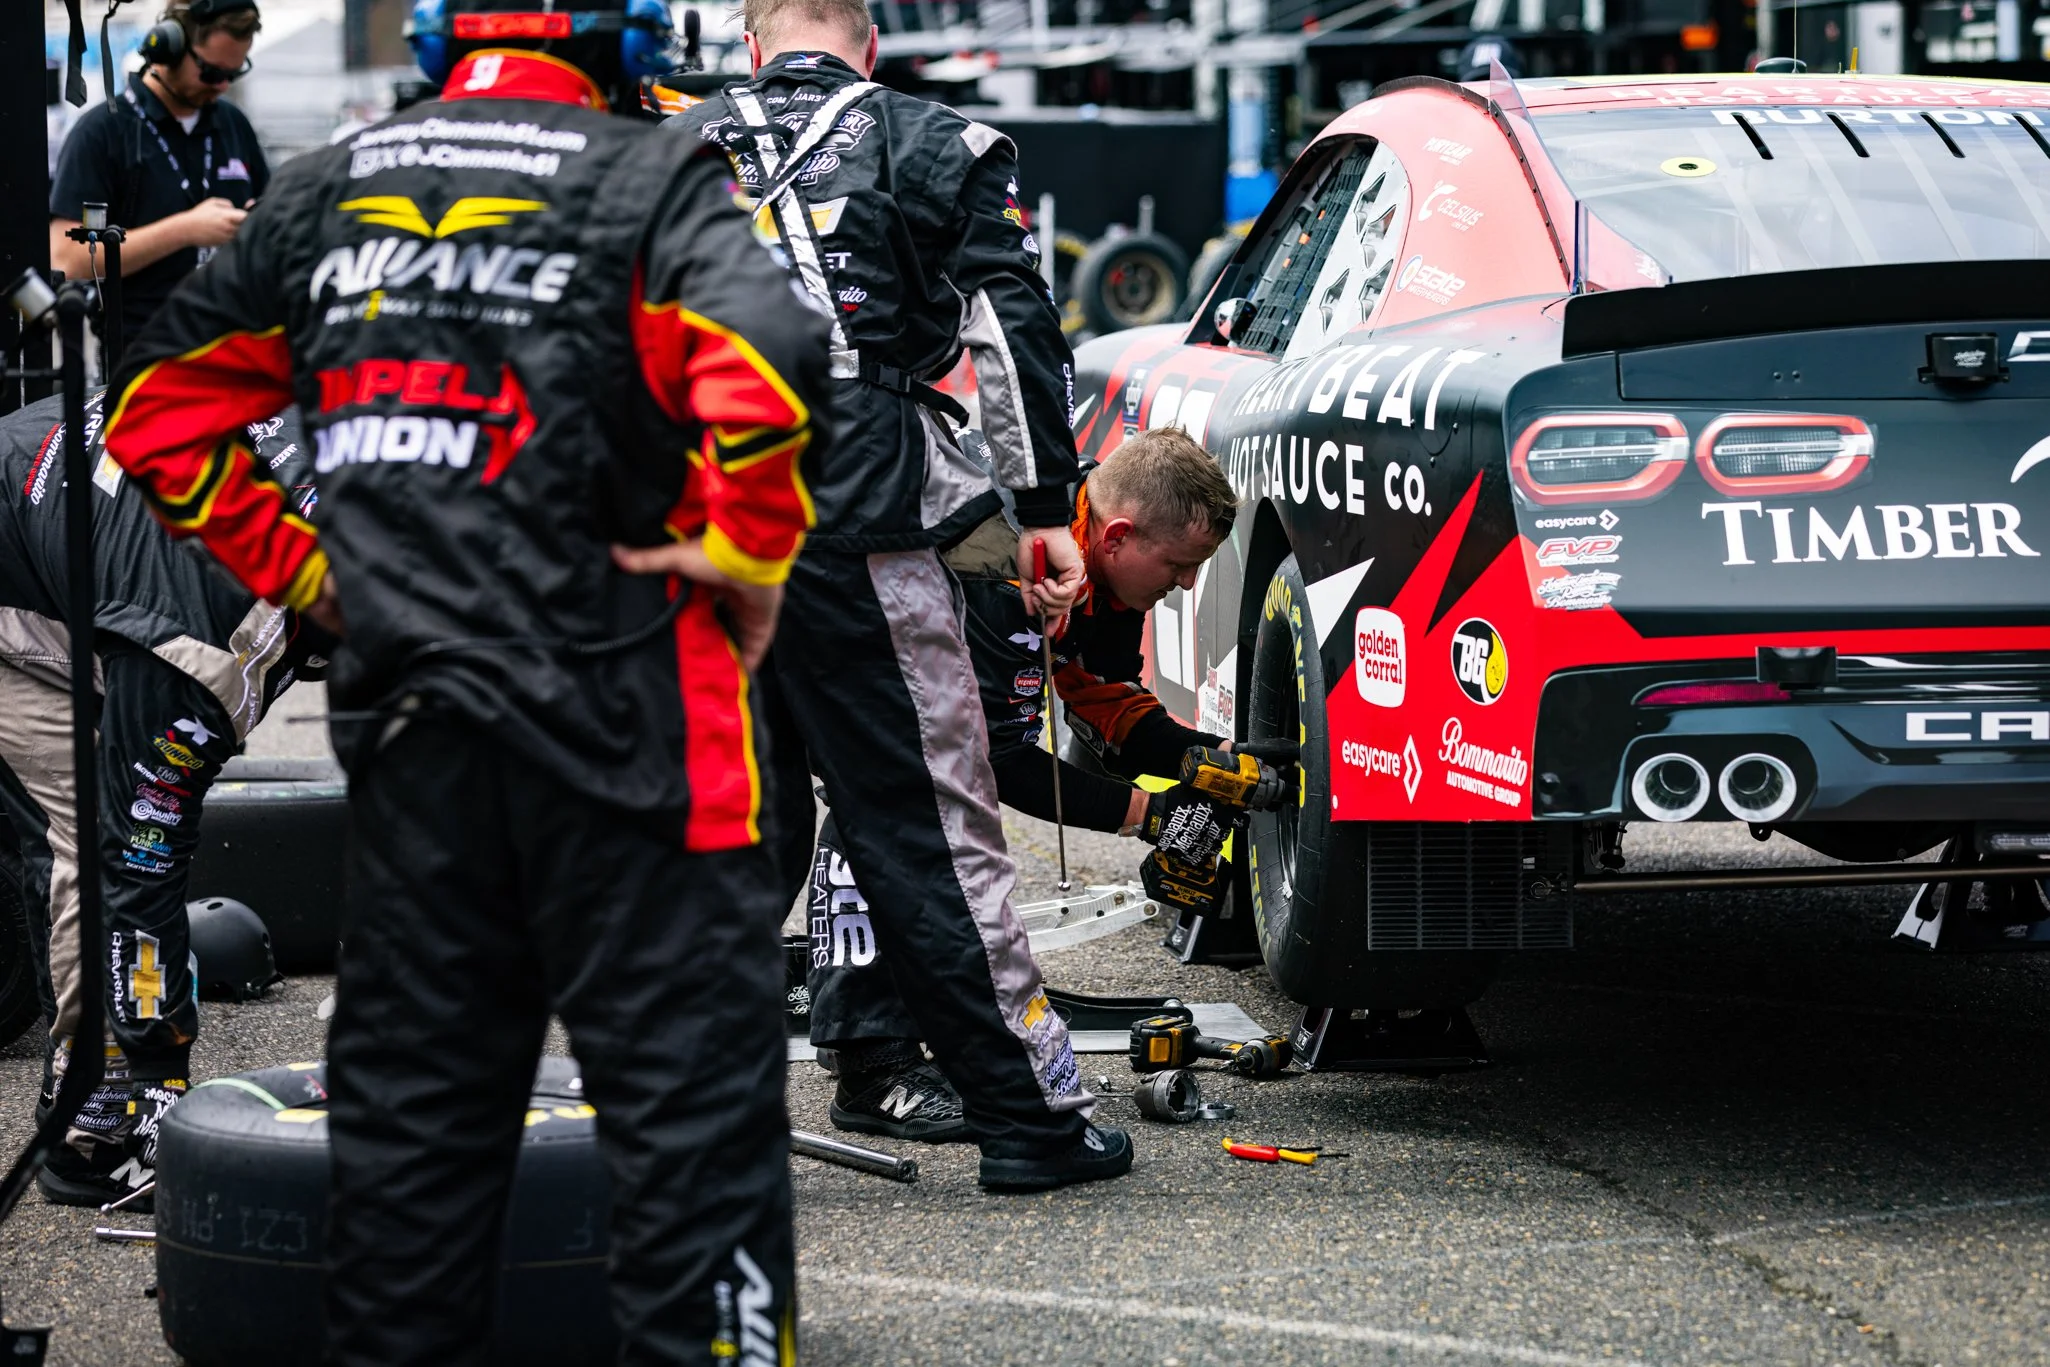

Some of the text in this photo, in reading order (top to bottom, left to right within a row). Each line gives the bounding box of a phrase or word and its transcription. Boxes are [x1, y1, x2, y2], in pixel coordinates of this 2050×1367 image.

[1797, 94, 1981, 105] SAUCE
[1711, 109, 2046, 127] BURTON
[1437, 198, 1485, 226] CELSIUS
[1413, 265, 1466, 298] state
[1234, 345, 1489, 431] HEARTBEAT
[1228, 433, 1433, 518] HOT SAUCE CO.
[1535, 516, 1597, 530] easycare
[1701, 501, 2041, 566] TIMBER
[1538, 536, 1618, 558] FVP
[1358, 629, 1399, 660] golden
[1454, 632, 1490, 686] BG
[1364, 658, 1403, 685] corral
[155, 738, 204, 769] SUNOCO
[1342, 739, 1401, 778] easycare
[1446, 770, 1522, 808] AUTOMOTIVE GROUP
[1171, 802, 1215, 854] Mechanix
[812, 848, 830, 970] HEATERS
